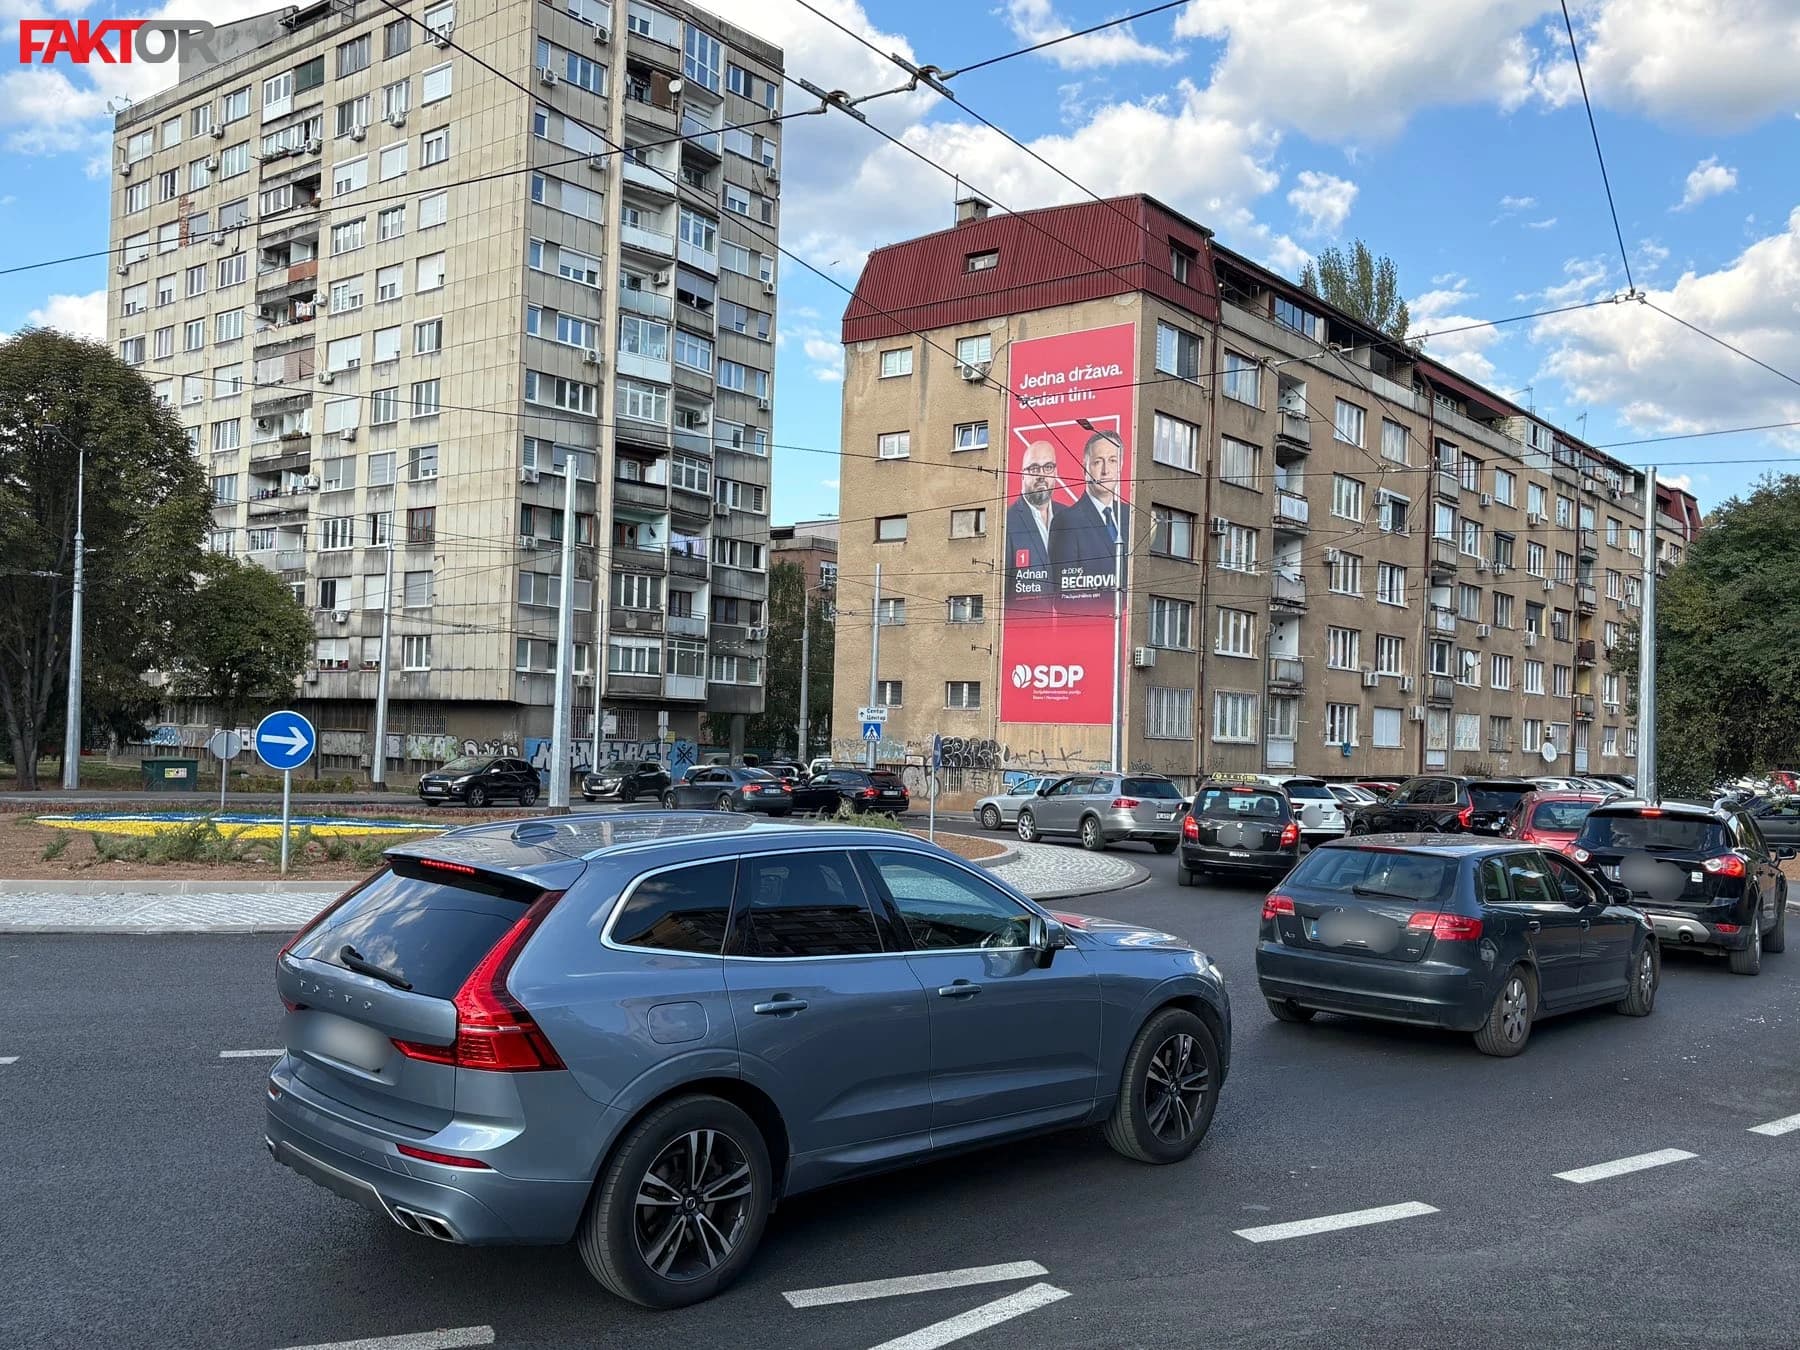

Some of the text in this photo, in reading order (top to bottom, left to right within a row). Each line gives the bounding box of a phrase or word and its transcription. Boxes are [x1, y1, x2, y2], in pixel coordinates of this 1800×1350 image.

[1019, 363, 1123, 390] Jedna država.
[1068, 386, 1096, 402] tim.
[1019, 553, 1025, 564] 1
[1015, 569, 1048, 580] Adnan
[1015, 580, 1042, 593] Šteta
[1033, 664, 1084, 688] SDP
